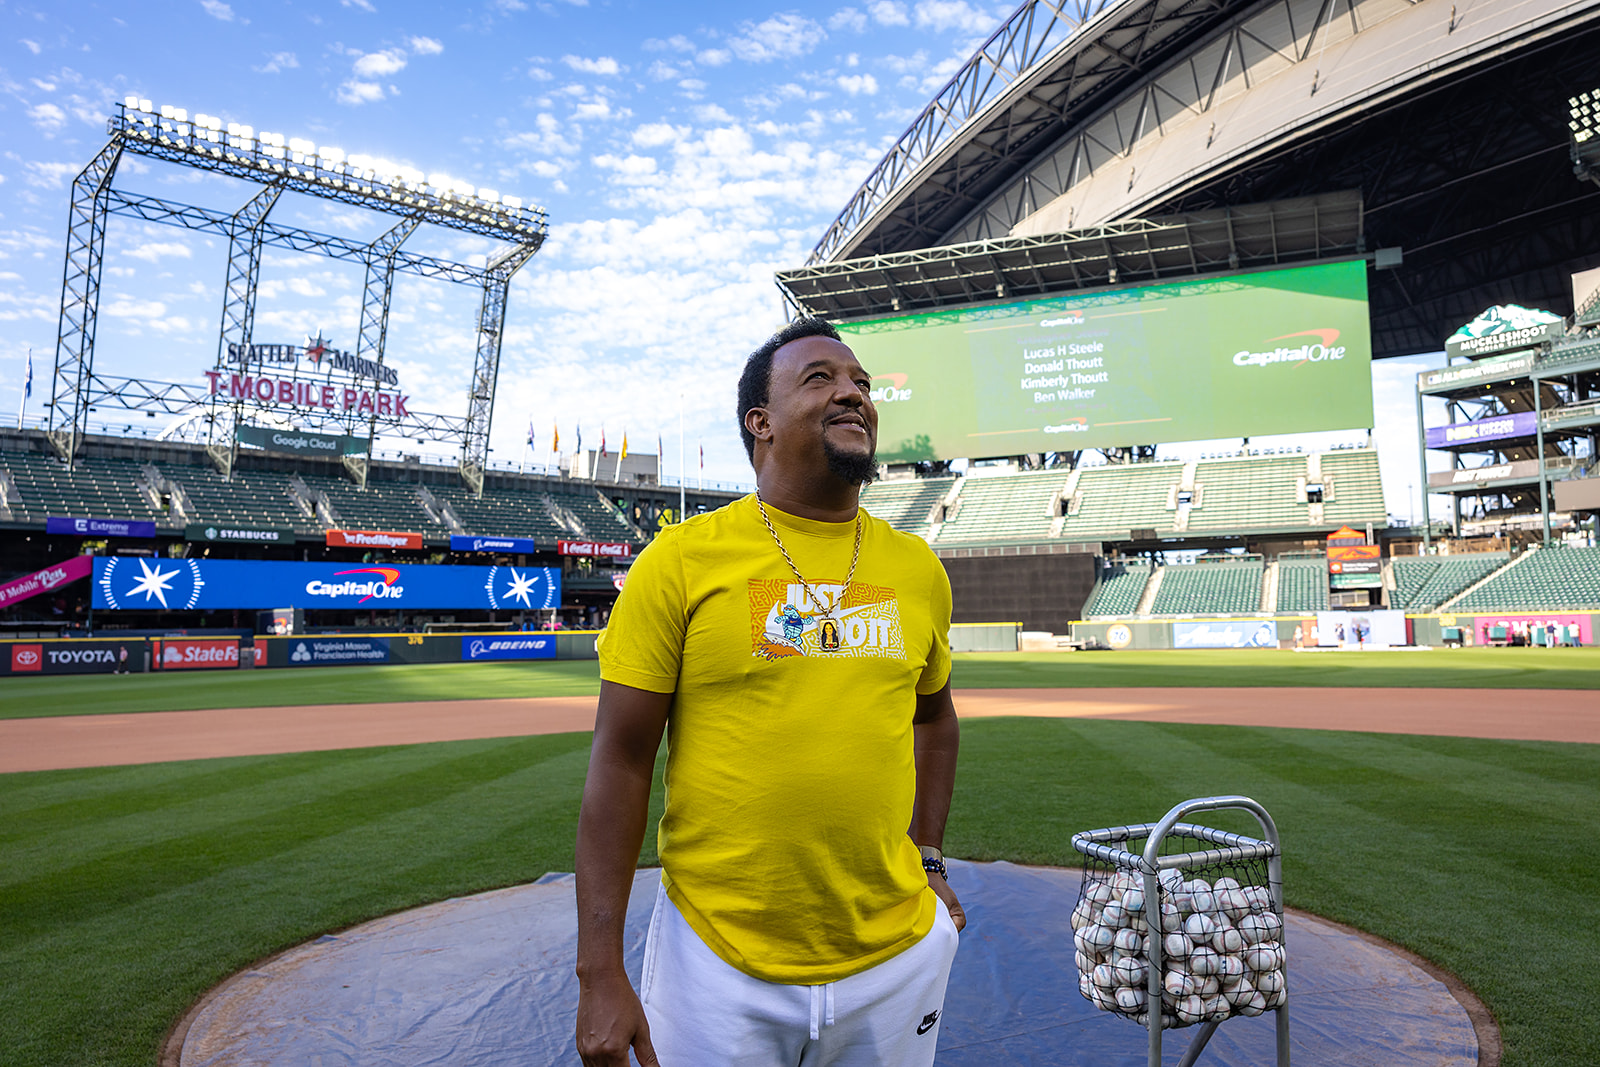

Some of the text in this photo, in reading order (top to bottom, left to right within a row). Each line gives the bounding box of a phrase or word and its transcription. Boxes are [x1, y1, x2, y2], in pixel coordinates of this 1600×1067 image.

[1460, 325, 1548, 351] MUCKLESHOOT
[1475, 338, 1532, 353] INDIAN TRIBE
[1023, 341, 1104, 360] Lucas H Steele
[227, 343, 398, 386] SEATTLE MARINERS
[1024, 357, 1104, 374] Donald Thoutt
[1021, 371, 1109, 389] Kimberly Thoutt
[205, 370, 410, 417] T-MOBILE PARK
[1034, 387, 1096, 403] Ben Walker
[272, 433, 336, 450] Google Cloud
[90, 521, 129, 531] Extreme
[220, 529, 279, 541] STARBUCKS
[784, 583, 848, 613] JUST
[1112, 630, 1127, 641] 76
[313, 642, 371, 652] Virginia Mason
[489, 640, 547, 650] BOEING
[48, 650, 116, 664] TOYOTA
[313, 650, 385, 660] Franciscan Health
